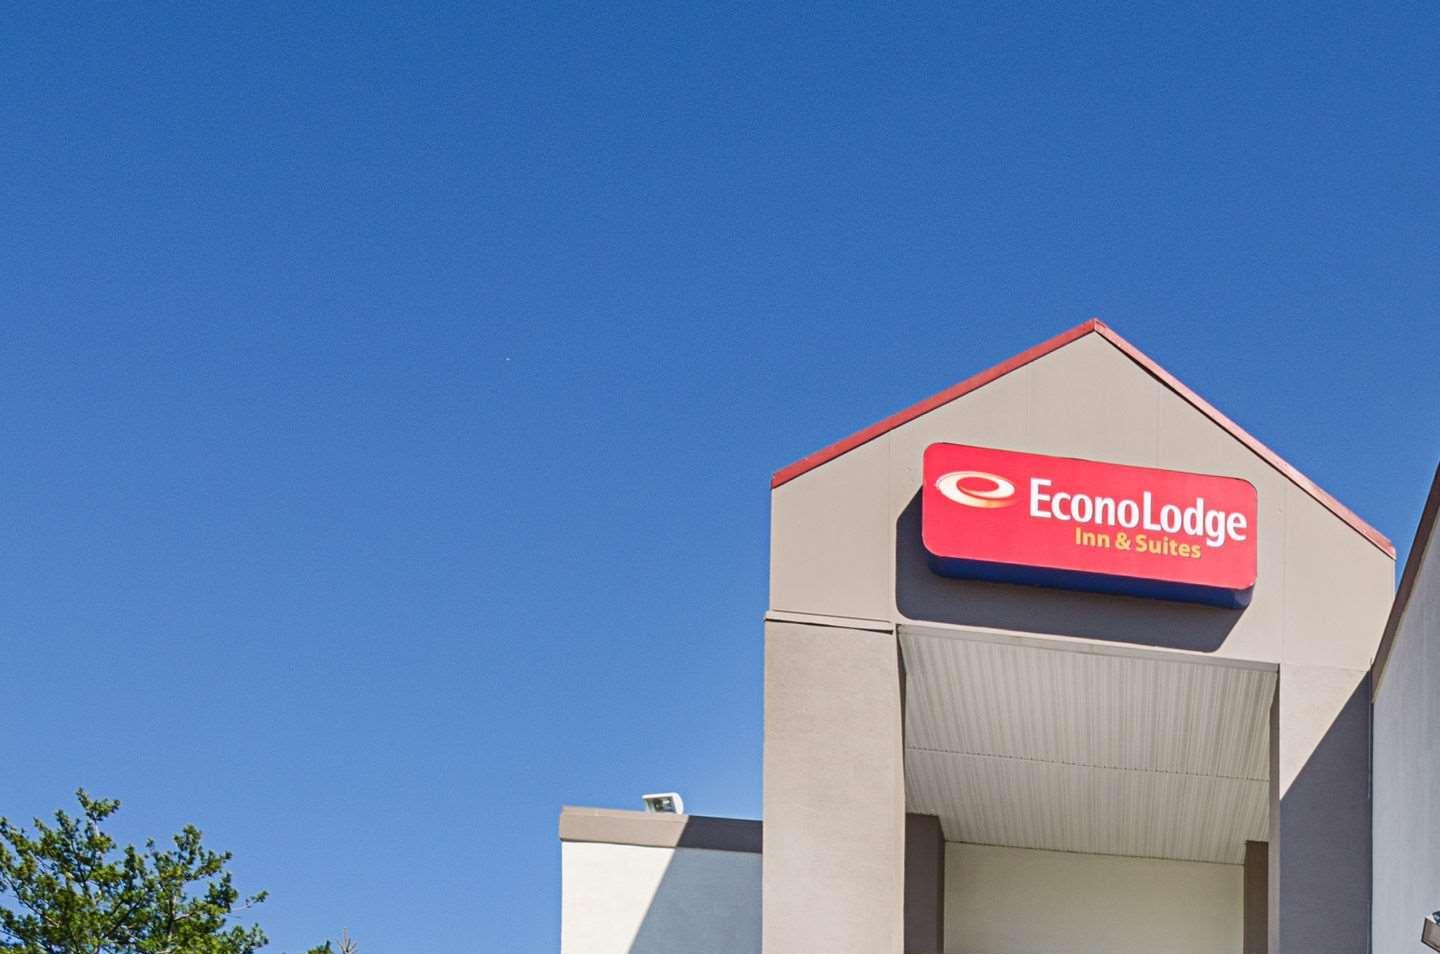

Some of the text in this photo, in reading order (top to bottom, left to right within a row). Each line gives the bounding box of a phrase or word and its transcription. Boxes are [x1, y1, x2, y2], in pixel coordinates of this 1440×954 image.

[1030, 477, 1247, 547] EconoLodge
[1075, 527, 1202, 558] Inn & Suites
